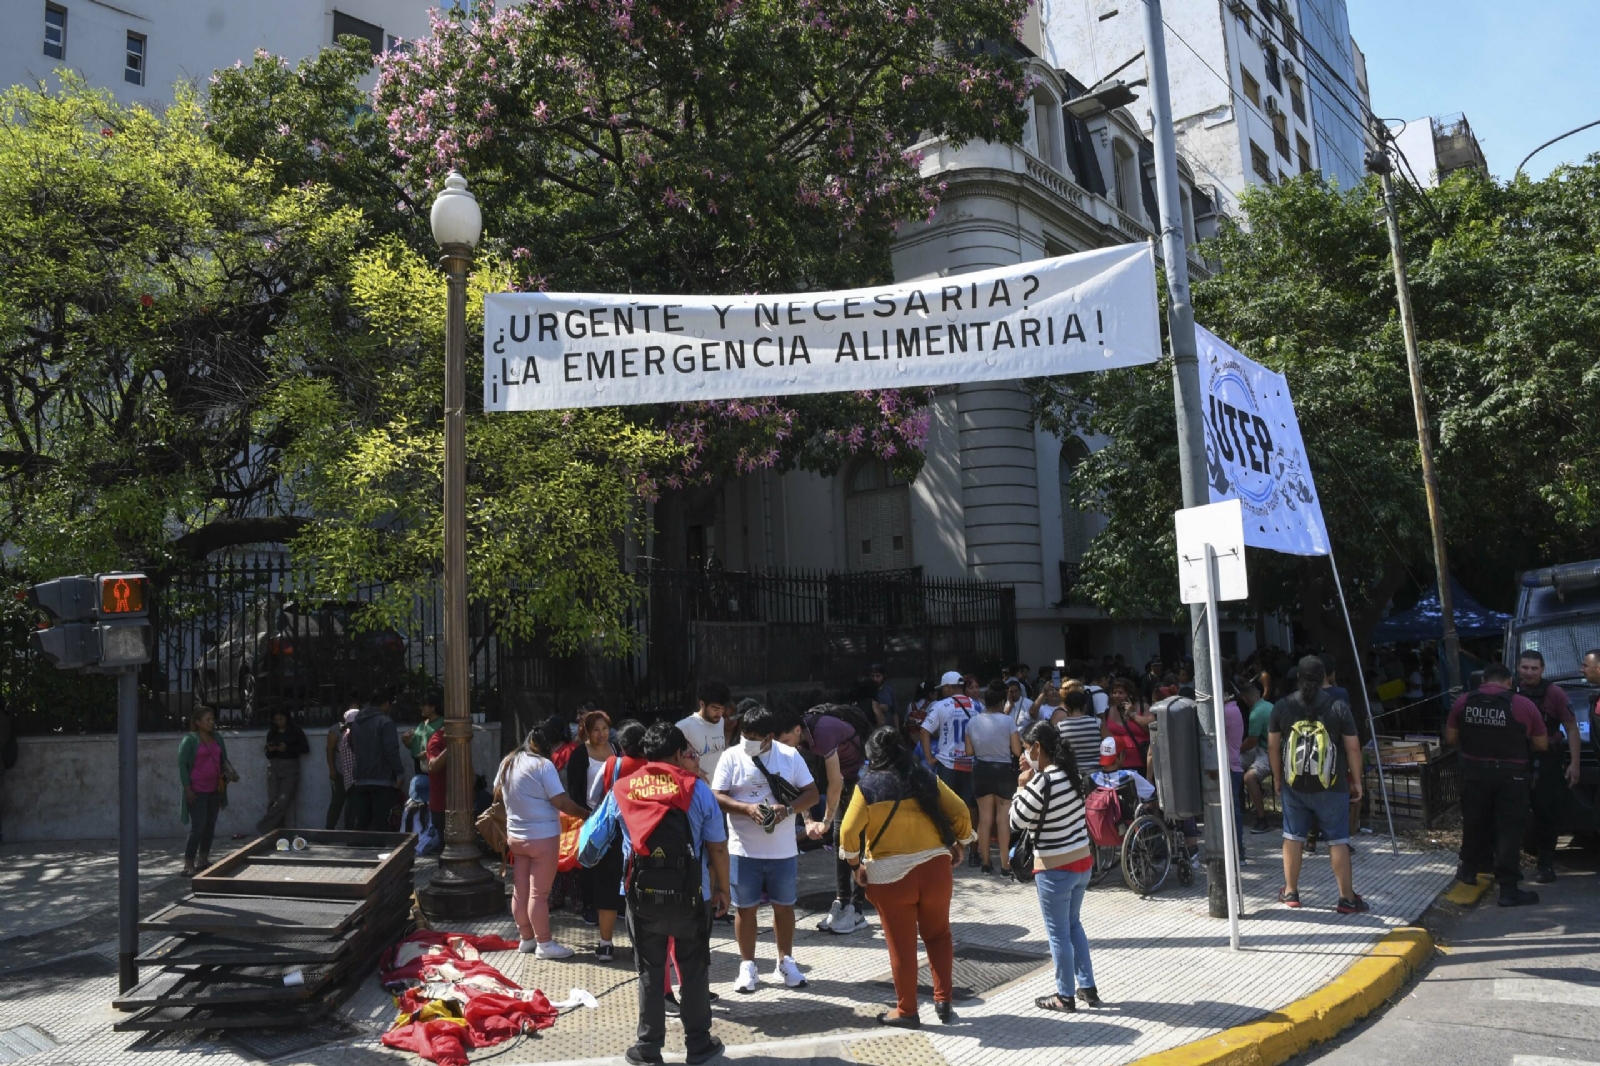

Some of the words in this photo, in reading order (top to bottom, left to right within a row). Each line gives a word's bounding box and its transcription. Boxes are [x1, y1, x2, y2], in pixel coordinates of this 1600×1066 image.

[493, 304, 684, 353] ¿URGENTE
[711, 304, 734, 330] Y
[754, 274, 1040, 328] NECESARIA?
[492, 355, 541, 403] ¡LA
[563, 335, 811, 382] EMERGENCIA
[834, 310, 1104, 363] ALIMENTARIA!
[1209, 394, 1274, 475] UTEP
[1465, 706, 1506, 720] POLICIA
[1474, 717, 1483, 725] LA
[1483, 718, 1506, 727] CIUDAD
[629, 774, 674, 789] PARTIDO
